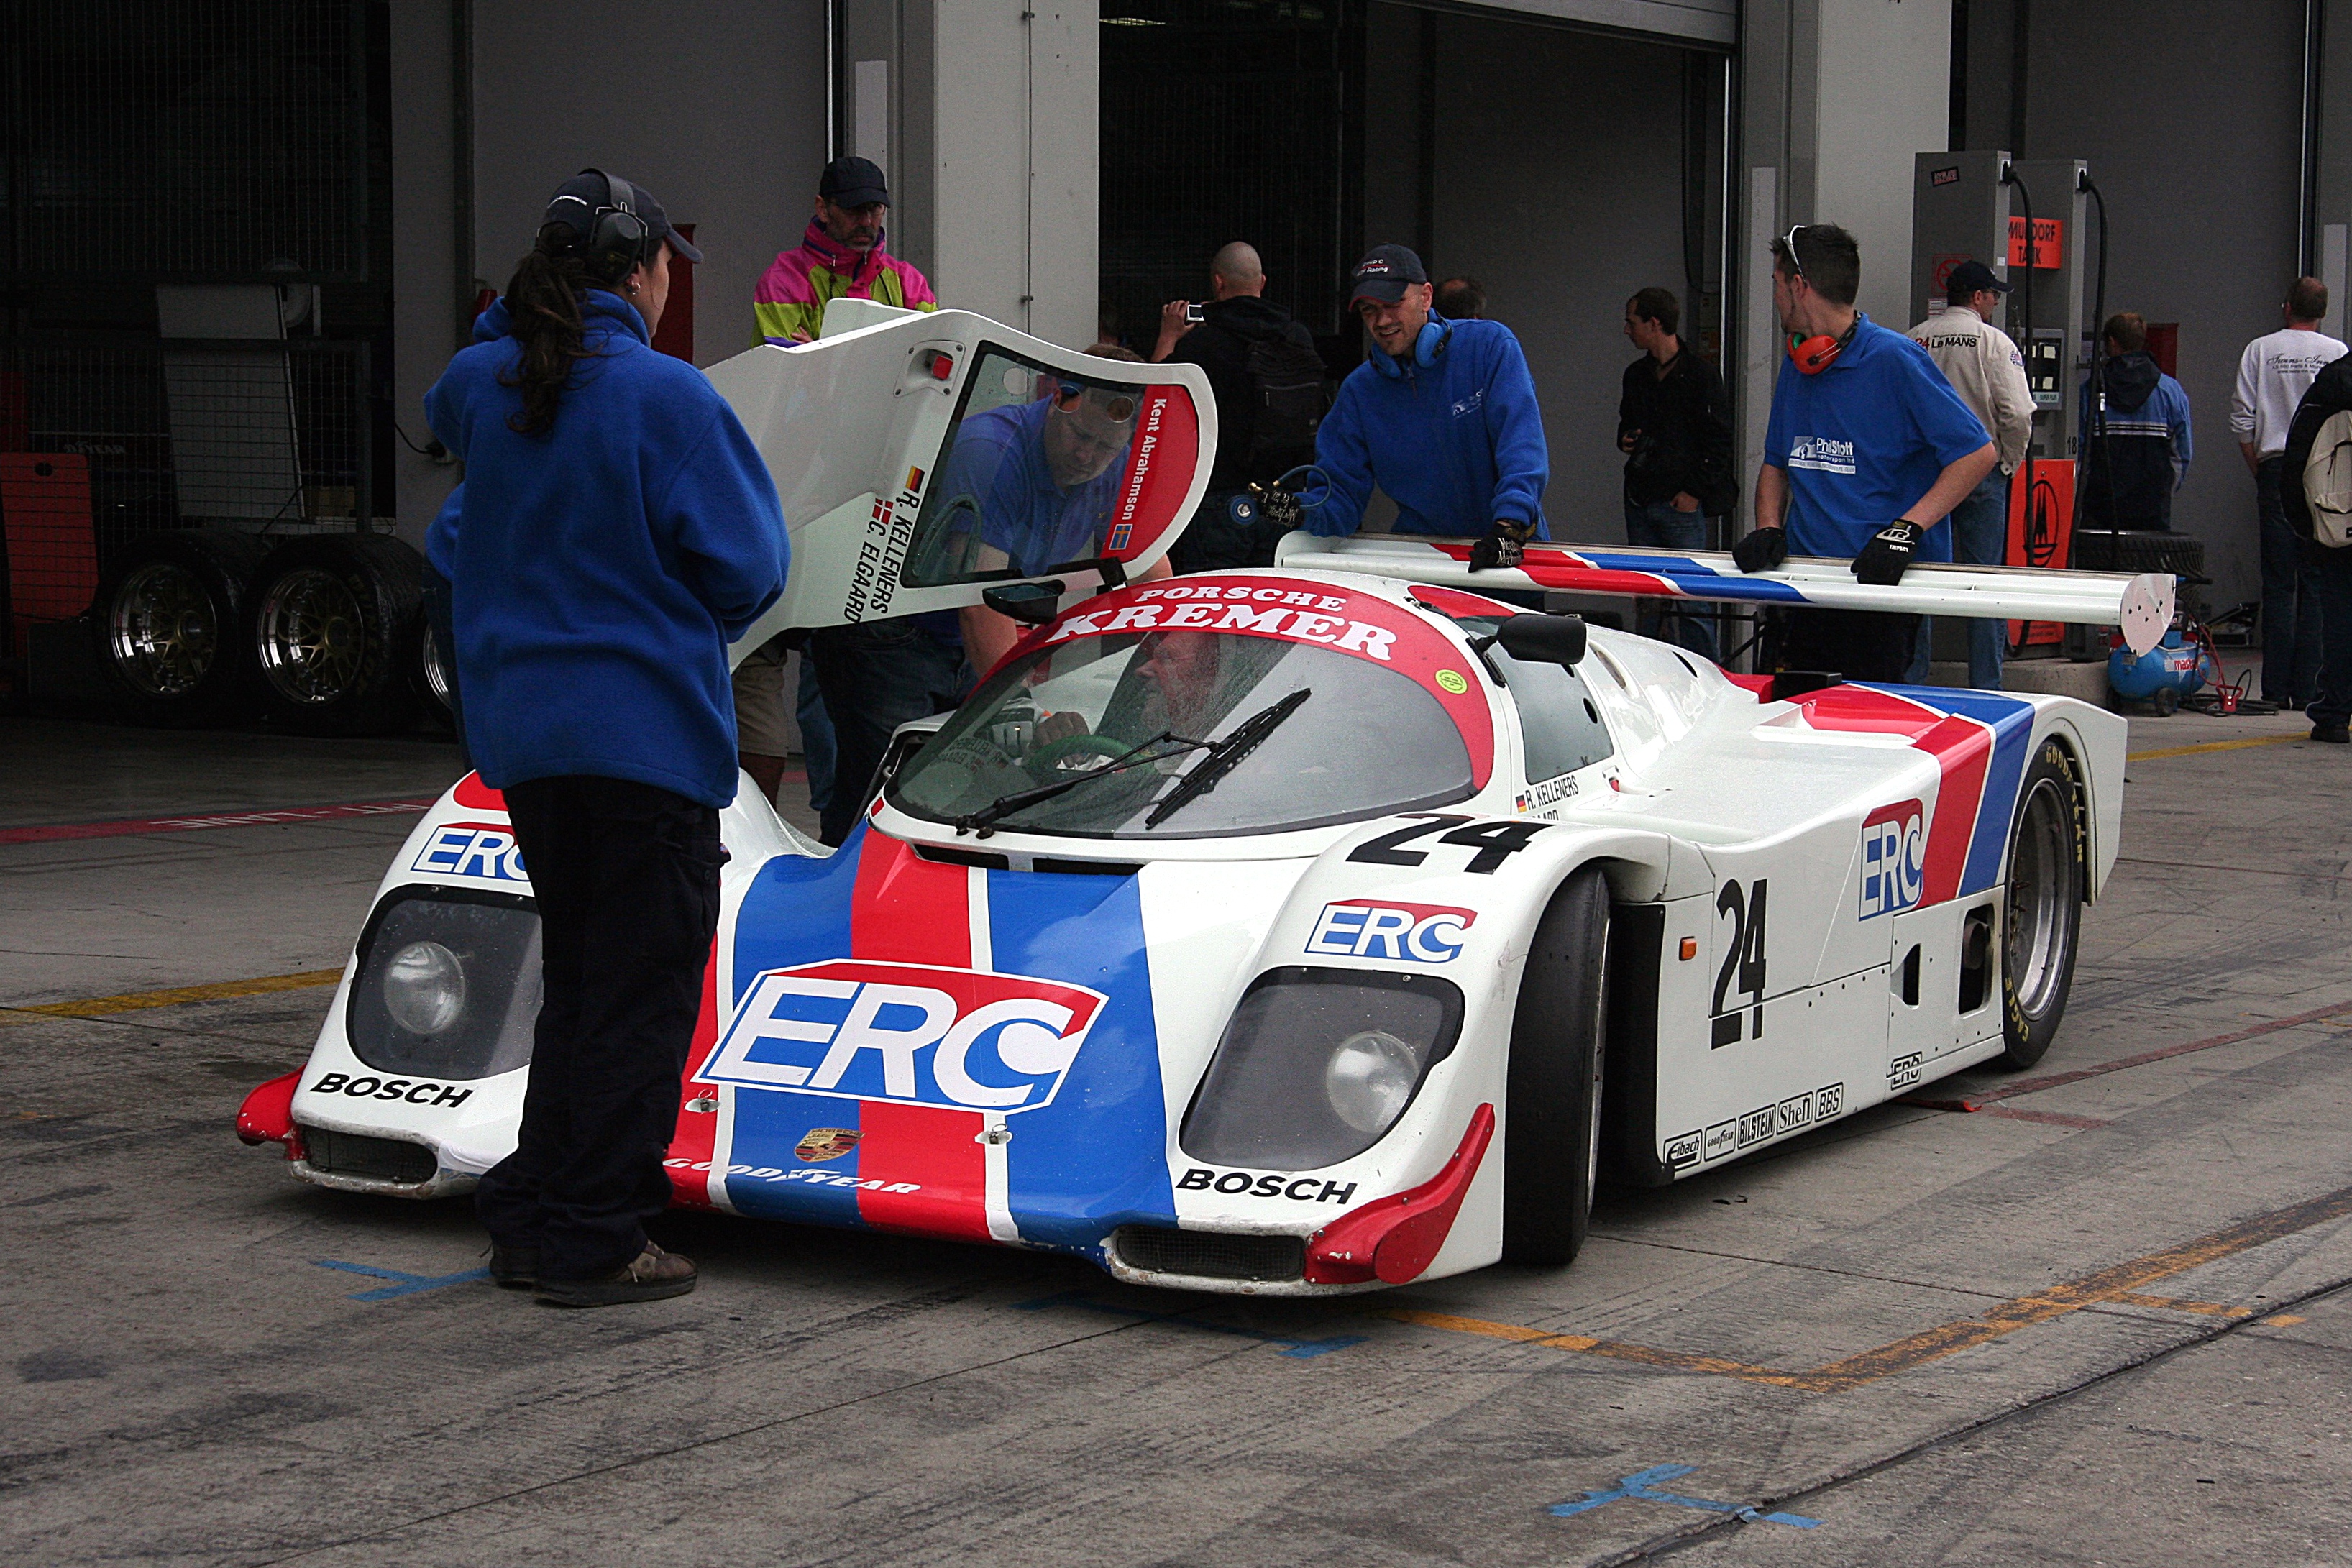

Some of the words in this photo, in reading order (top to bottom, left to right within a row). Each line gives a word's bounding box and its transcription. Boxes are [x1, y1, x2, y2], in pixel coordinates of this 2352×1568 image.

[2008, 221, 2055, 242] MUDORF
[2018, 246, 2042, 264] TAK
[1931, 338, 1944, 349] Le
[1944, 336, 1977, 348] MANS
[1147, 398, 1167, 432] Kent
[2067, 436, 2077, 454] 18
[1122, 434, 1157, 521] Abrahamson
[866, 521, 886, 536] C.
[844, 541, 880, 624] ELGAARD
[870, 515, 913, 614] KELLENERS
[1135, 586, 1347, 612] PORSCHE
[1045, 603, 1398, 661] KREMER
[1525, 789, 1536, 810] R.
[1535, 774, 1579, 807] KELLENERS
[1345, 812, 1553, 875] 24
[1861, 812, 1924, 915] ERC
[1307, 904, 1469, 963] ERC
[1709, 879, 1767, 1050] 24
[707, 974, 1088, 1108] ERC
[310, 1073, 476, 1109] BOSCH
[1669, 1137, 1700, 1158] Eibach
[1739, 1109, 1775, 1143] BILSTEIN
[1779, 1096, 1811, 1129] Shell
[1818, 1088, 1840, 1115] BBS
[662, 1157, 921, 1195] GOODYEAR
[1175, 1169, 1358, 1205] BOSCH
